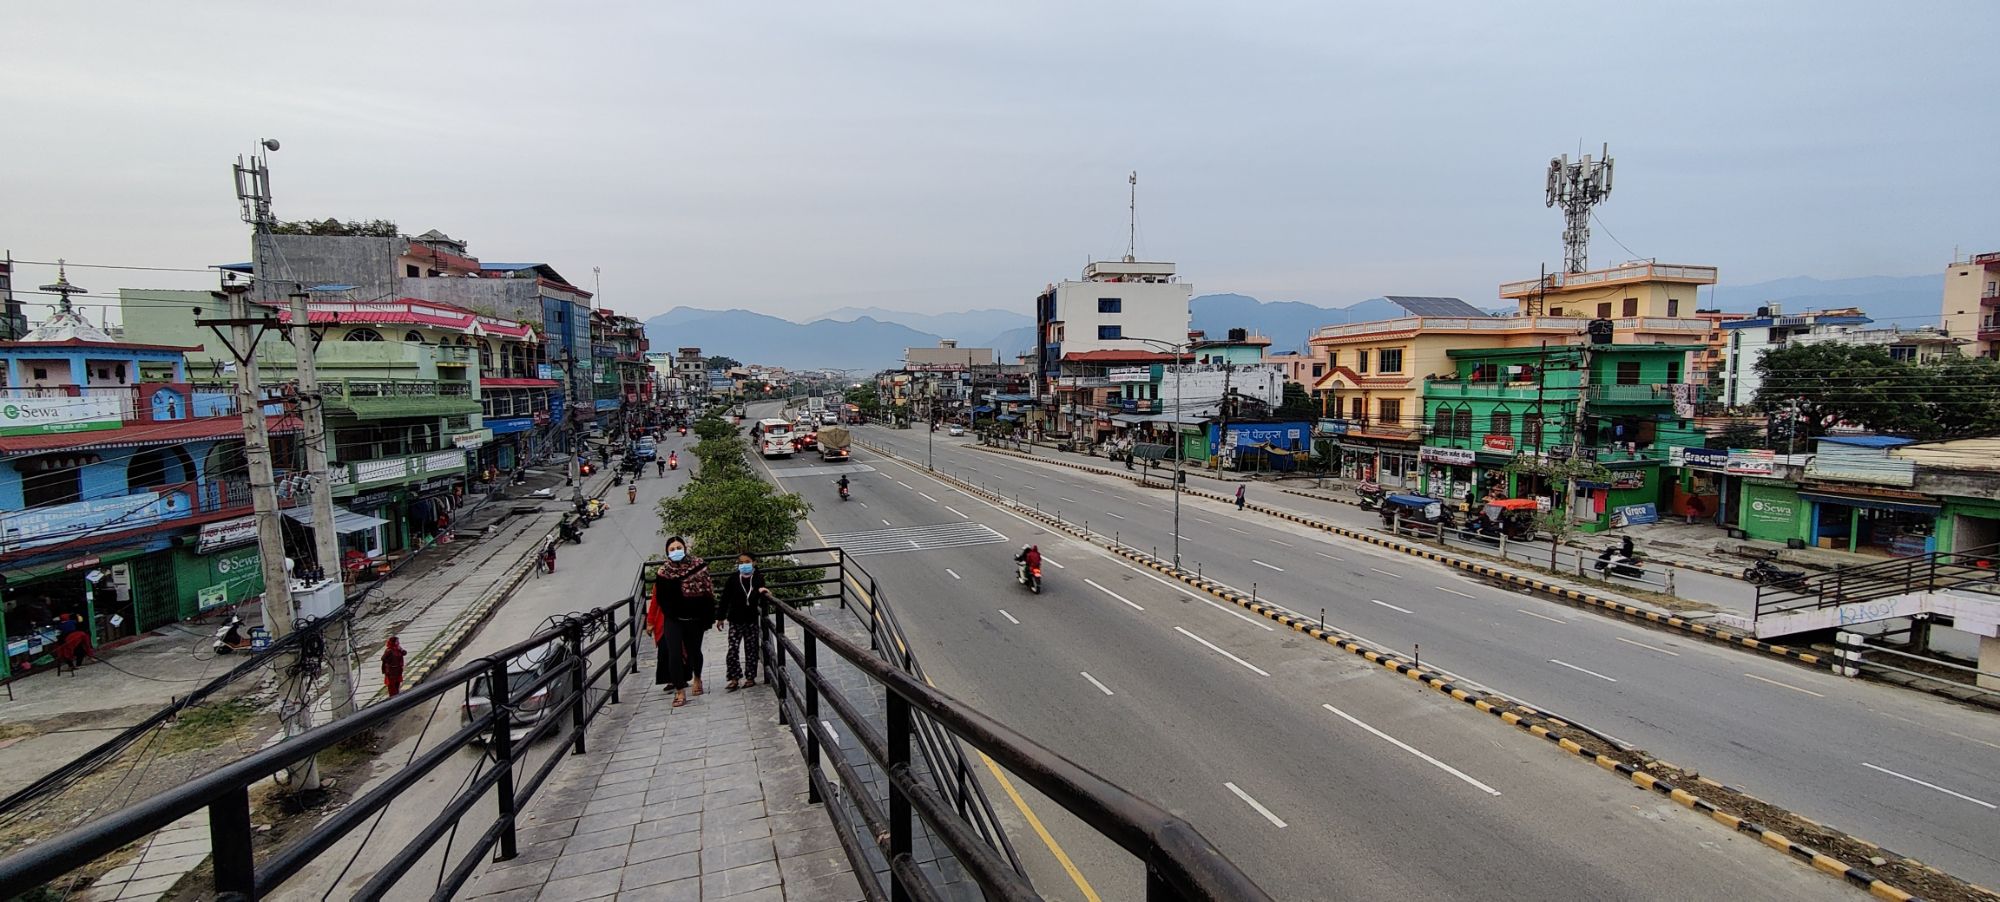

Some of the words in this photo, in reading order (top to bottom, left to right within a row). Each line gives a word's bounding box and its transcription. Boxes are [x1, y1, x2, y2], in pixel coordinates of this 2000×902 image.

[4, 404, 59, 420] eSewa
[1685, 452, 1709, 463] Grace
[1625, 506, 1646, 516] Grace
[1752, 501, 1791, 514] eSewa
[218, 555, 259, 573] eSewa
